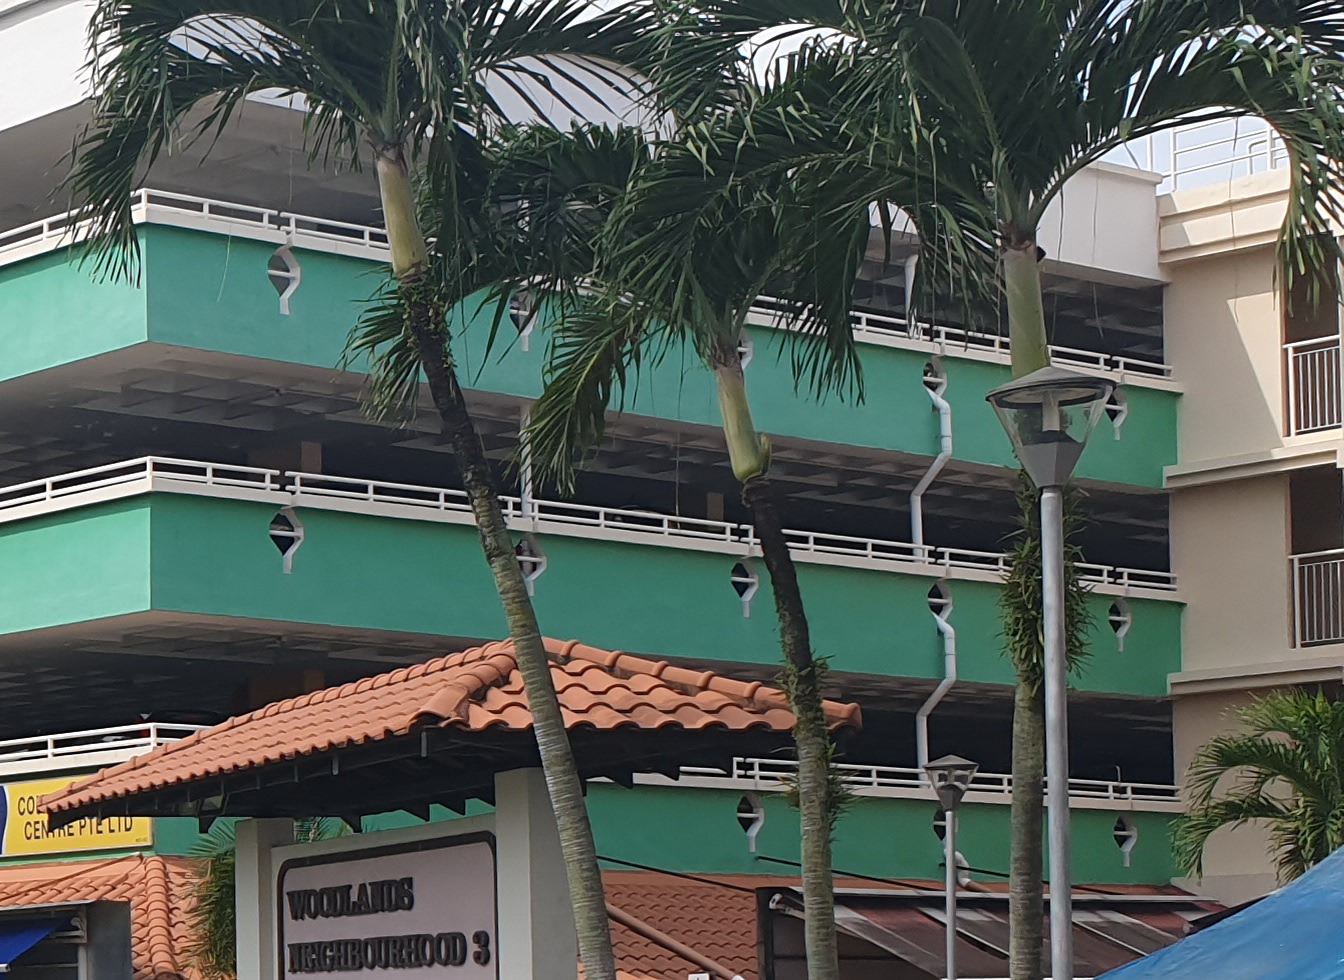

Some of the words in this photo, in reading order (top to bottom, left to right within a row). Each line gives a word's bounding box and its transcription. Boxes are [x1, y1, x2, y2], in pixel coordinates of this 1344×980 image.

[286, 877, 414, 921] WOODLANDS
[287, 932, 467, 974] NEIGHBOURHOOD
[472, 930, 490, 967] 3
